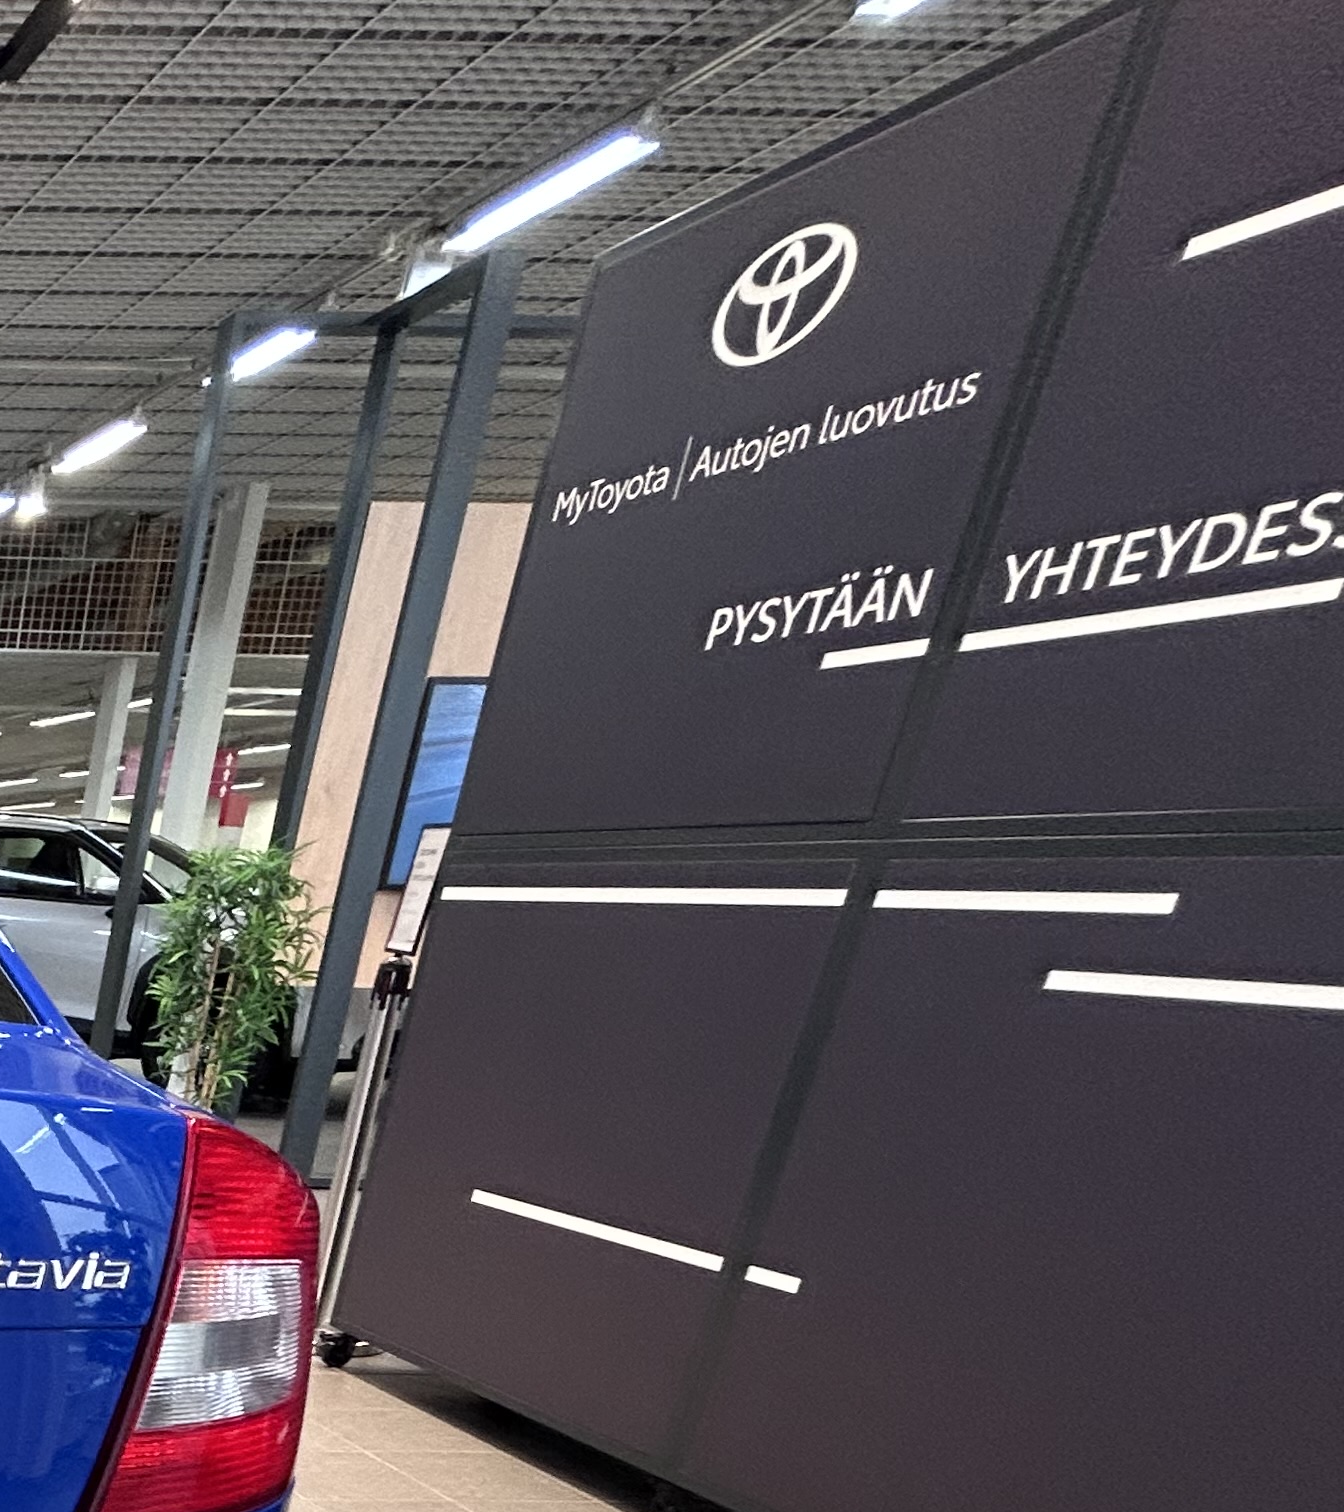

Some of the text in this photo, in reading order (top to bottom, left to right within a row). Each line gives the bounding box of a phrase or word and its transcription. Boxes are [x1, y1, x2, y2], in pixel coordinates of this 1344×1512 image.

[552, 370, 983, 526] MyToyota Autojen luovutus
[704, 491, 1344, 652] PYSYTÄÄN YHTEYDES
